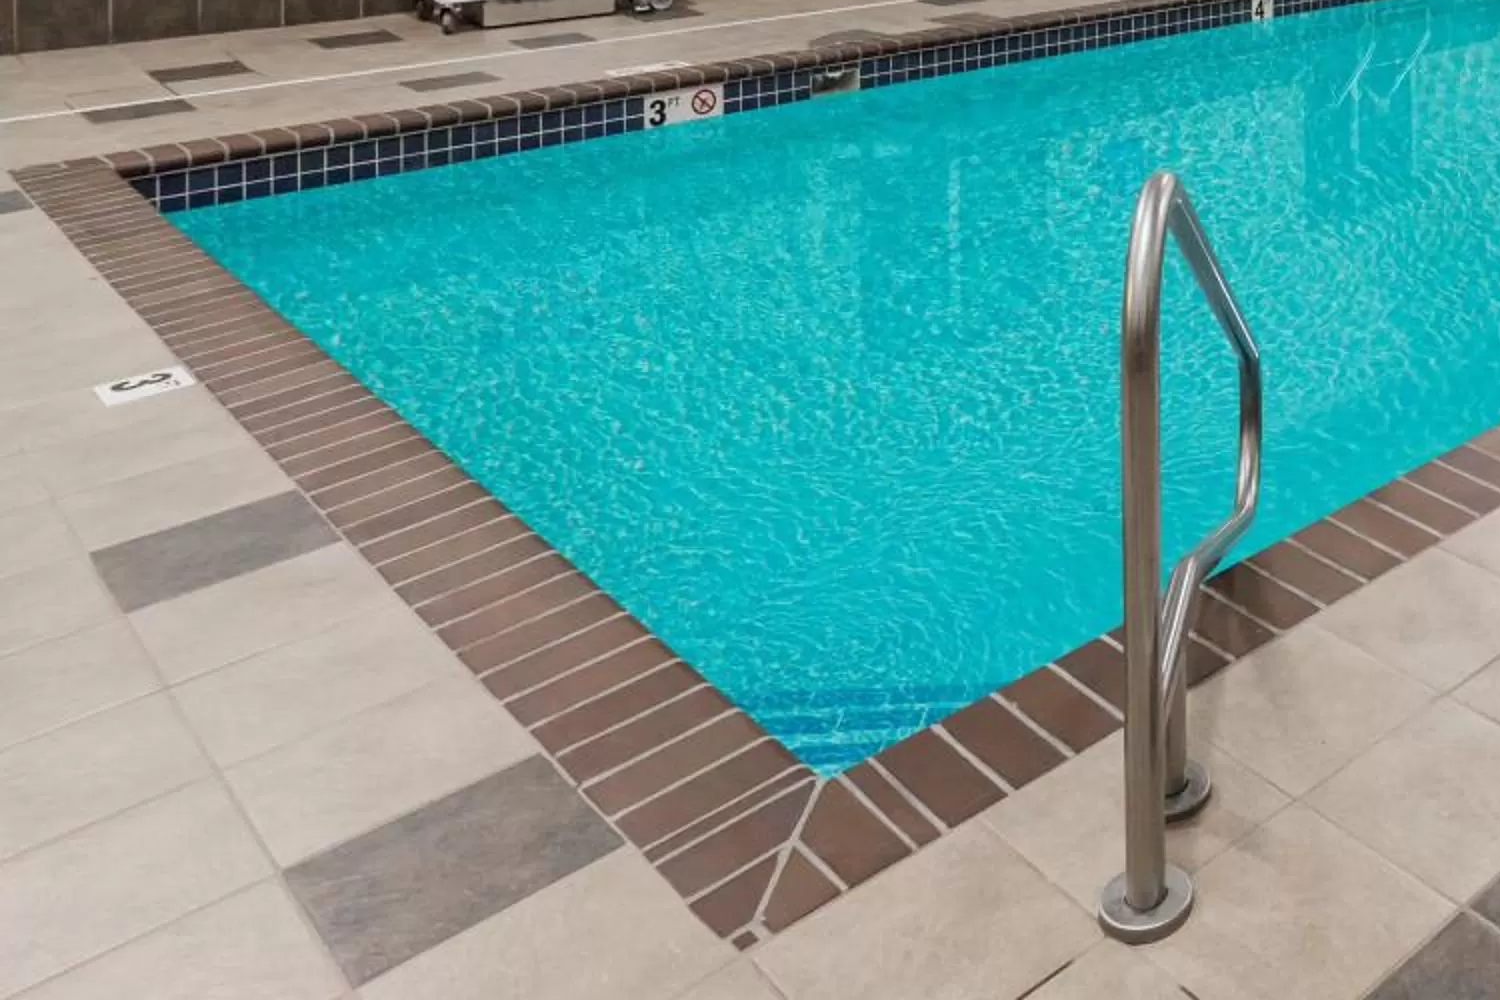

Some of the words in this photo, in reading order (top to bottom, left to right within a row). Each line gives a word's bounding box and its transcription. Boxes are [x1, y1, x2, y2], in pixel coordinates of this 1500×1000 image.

[1254, 0, 1265, 19] 4
[649, 99, 667, 127] 3
[109, 372, 173, 392] 3
